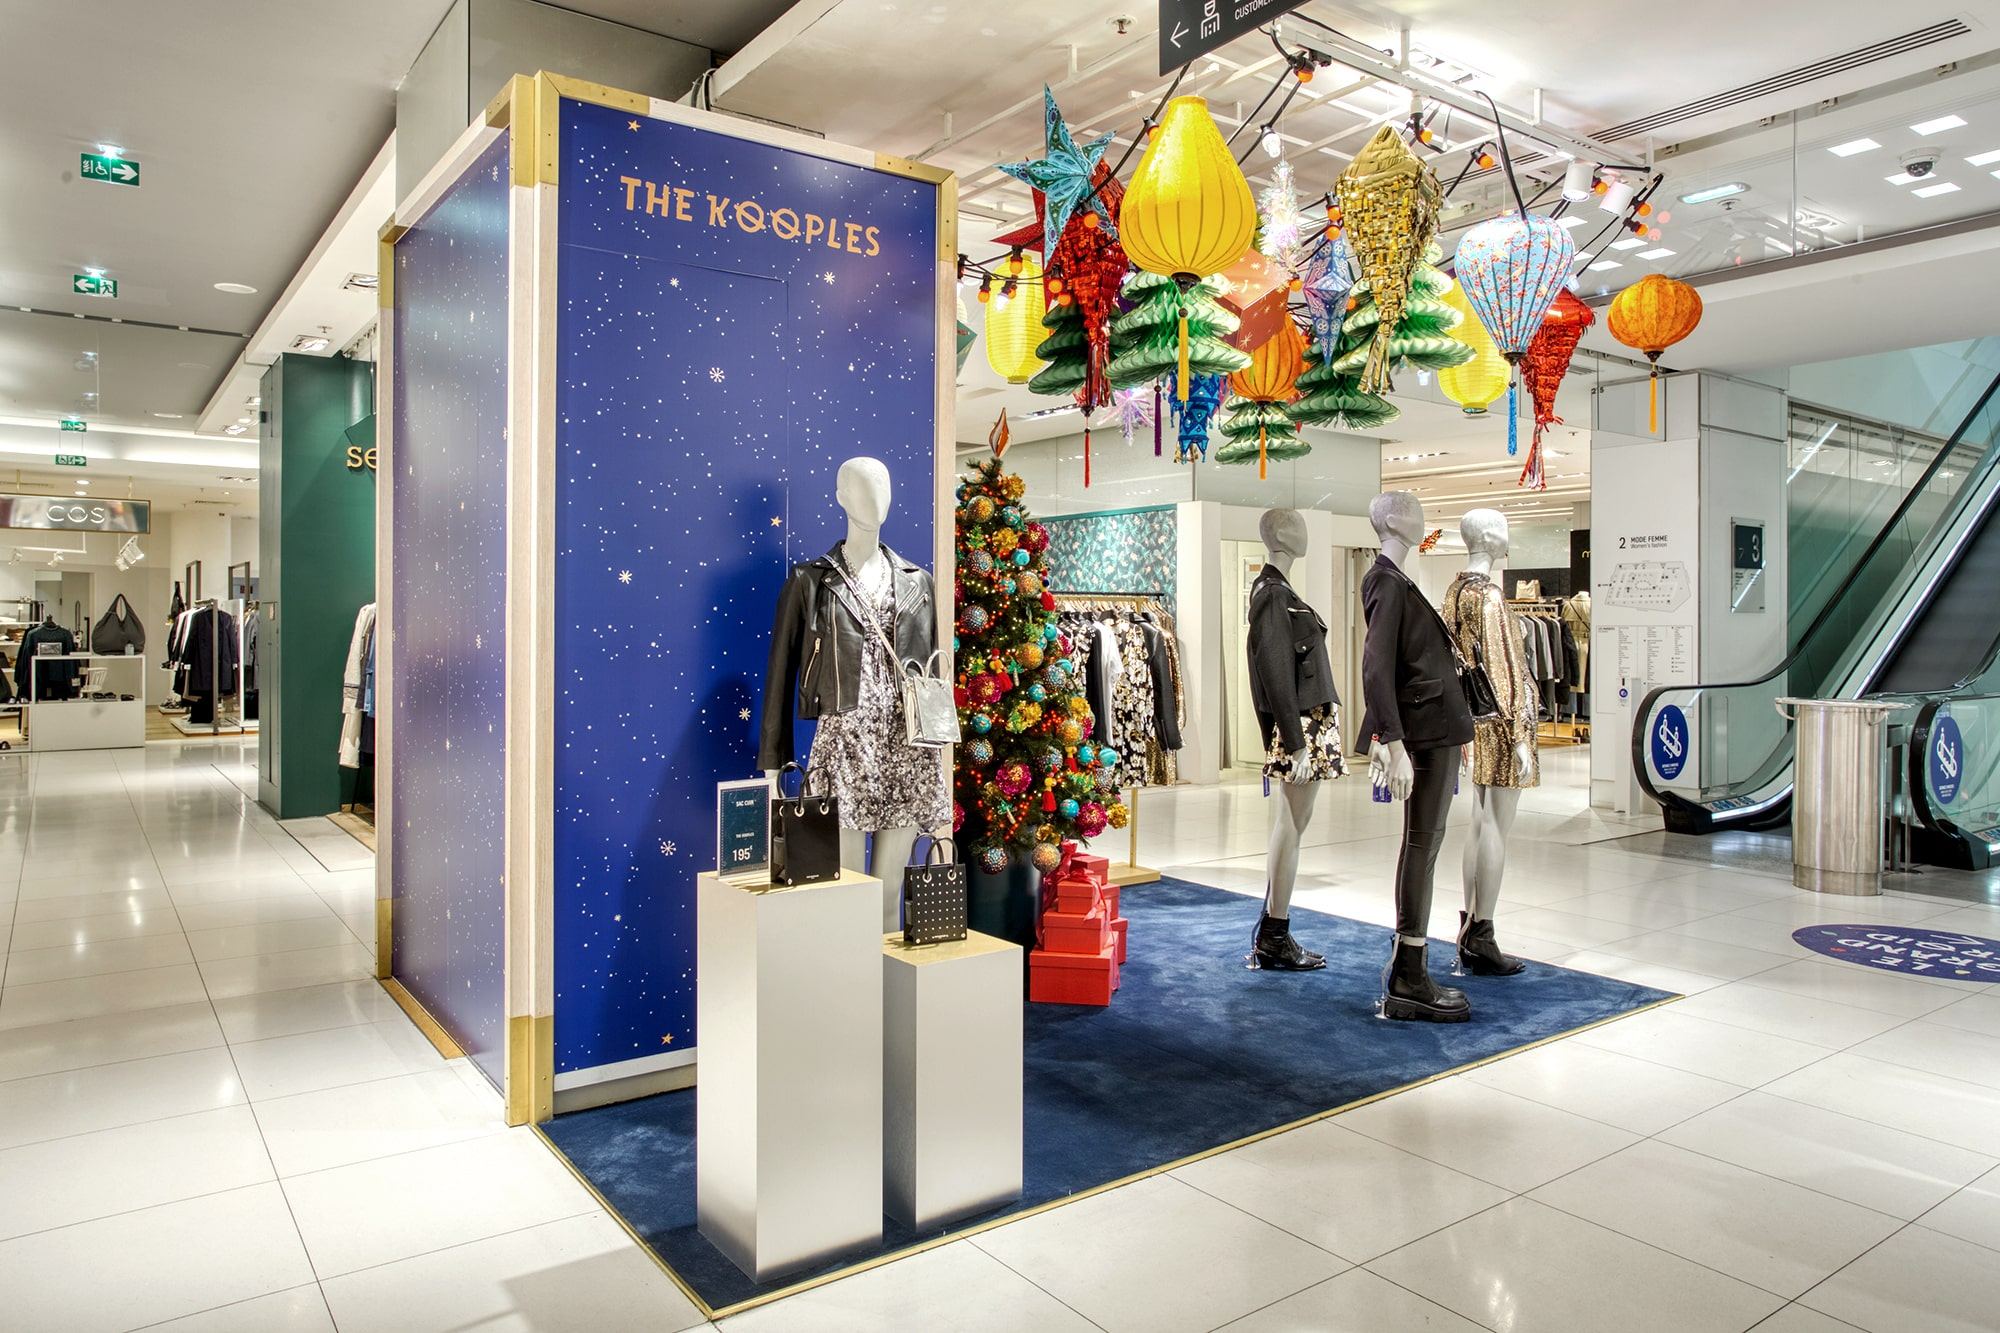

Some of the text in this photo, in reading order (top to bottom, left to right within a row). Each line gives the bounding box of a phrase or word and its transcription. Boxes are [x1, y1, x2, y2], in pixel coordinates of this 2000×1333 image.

[620, 175, 695, 222] THE
[46, 505, 105, 524] COS
[1619, 536, 1626, 549] 2
[1751, 533, 1760, 562] 3
[1870, 955, 1935, 971] LE
